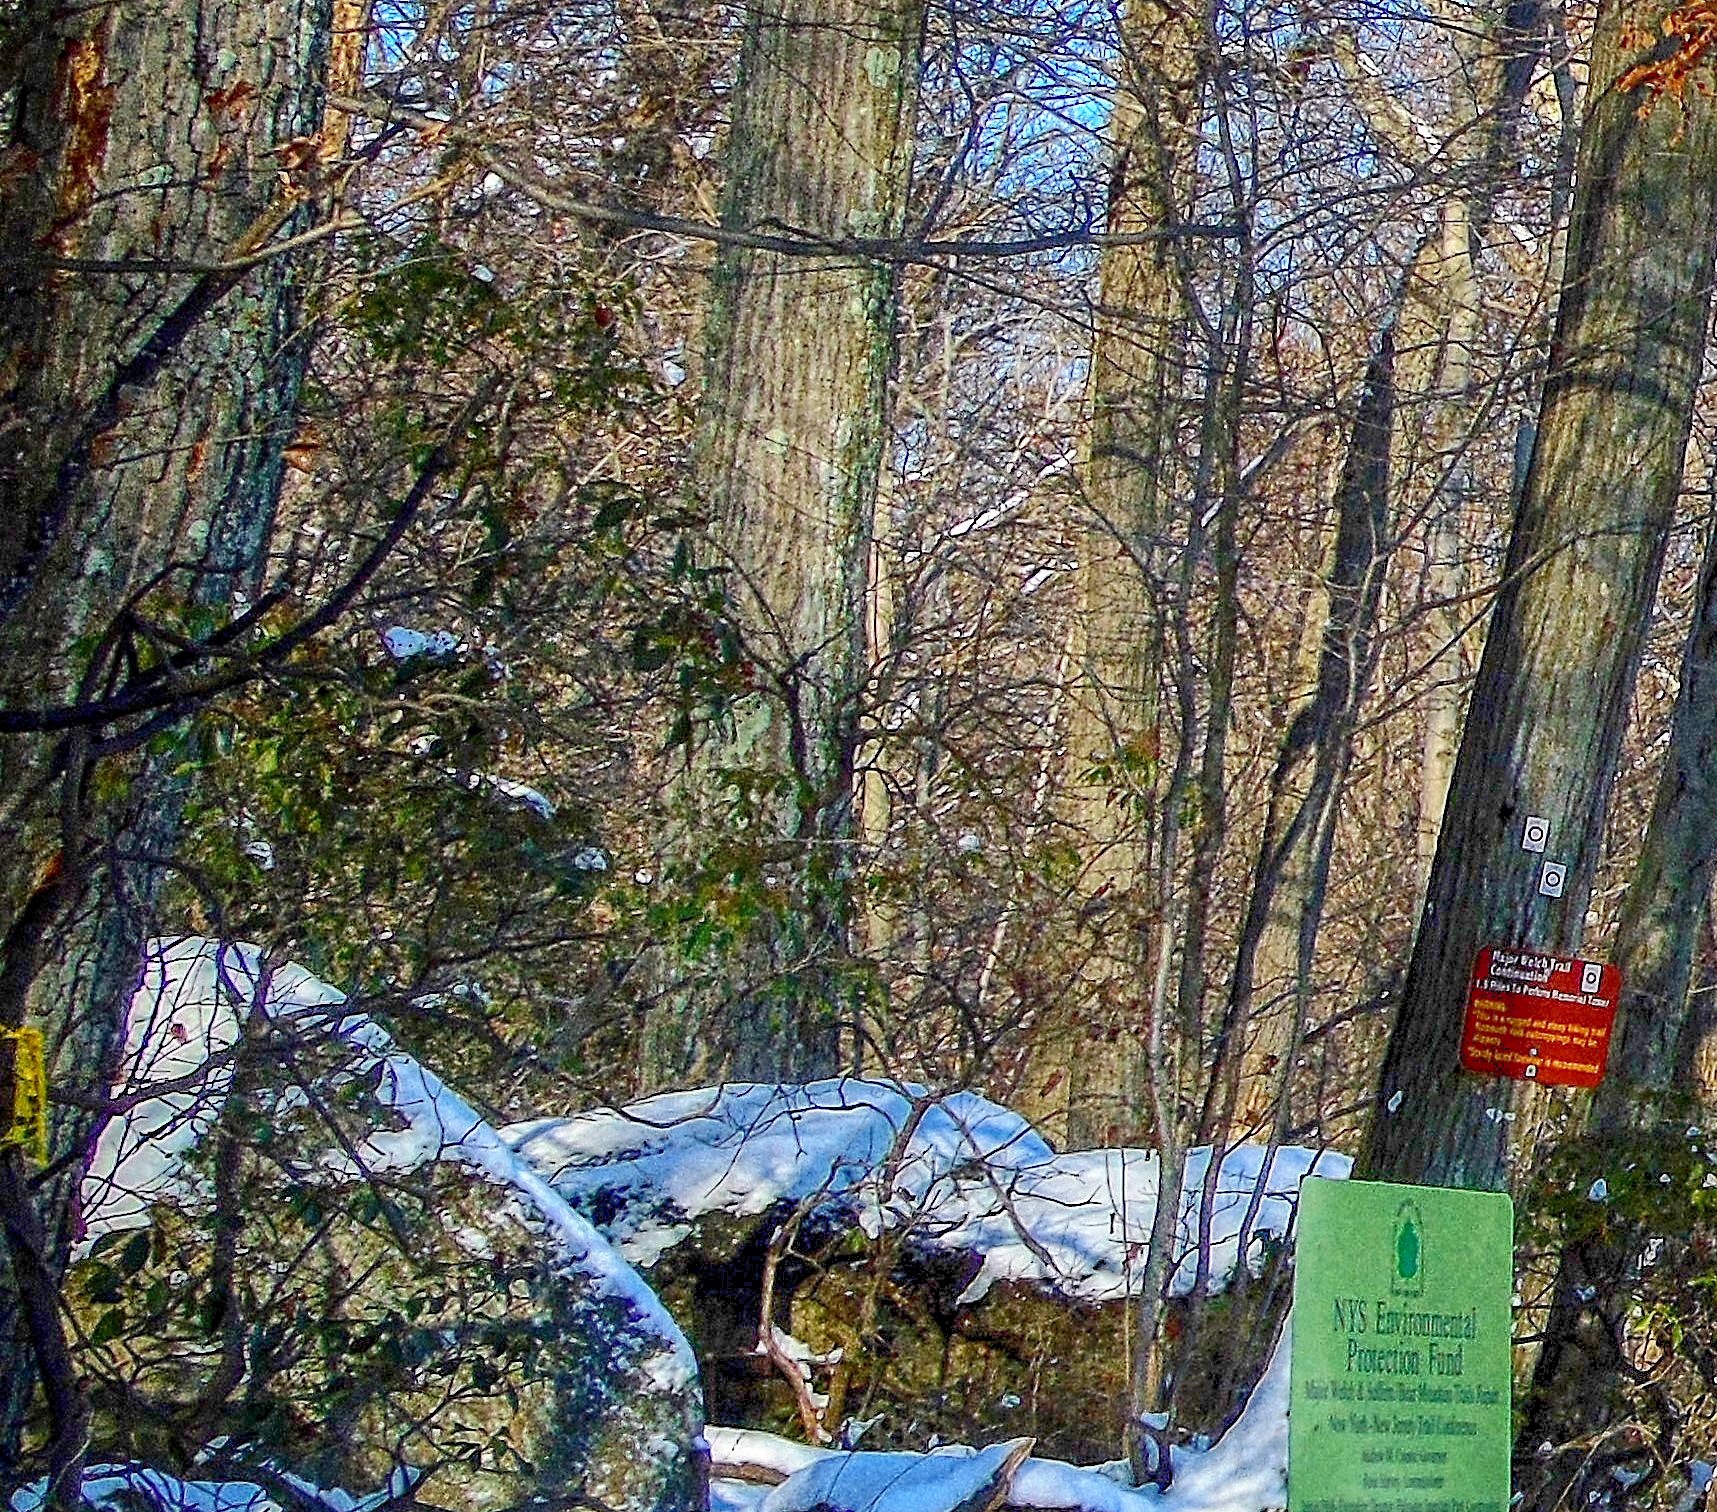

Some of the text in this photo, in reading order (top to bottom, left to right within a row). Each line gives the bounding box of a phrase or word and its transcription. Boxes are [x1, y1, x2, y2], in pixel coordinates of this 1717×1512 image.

[1490, 963, 1549, 983] Continuation
[1550, 958, 1572, 973] Trail
[1333, 1298, 1477, 1339] NYS Environmental
[1345, 1338, 1465, 1376] Protection Fund
